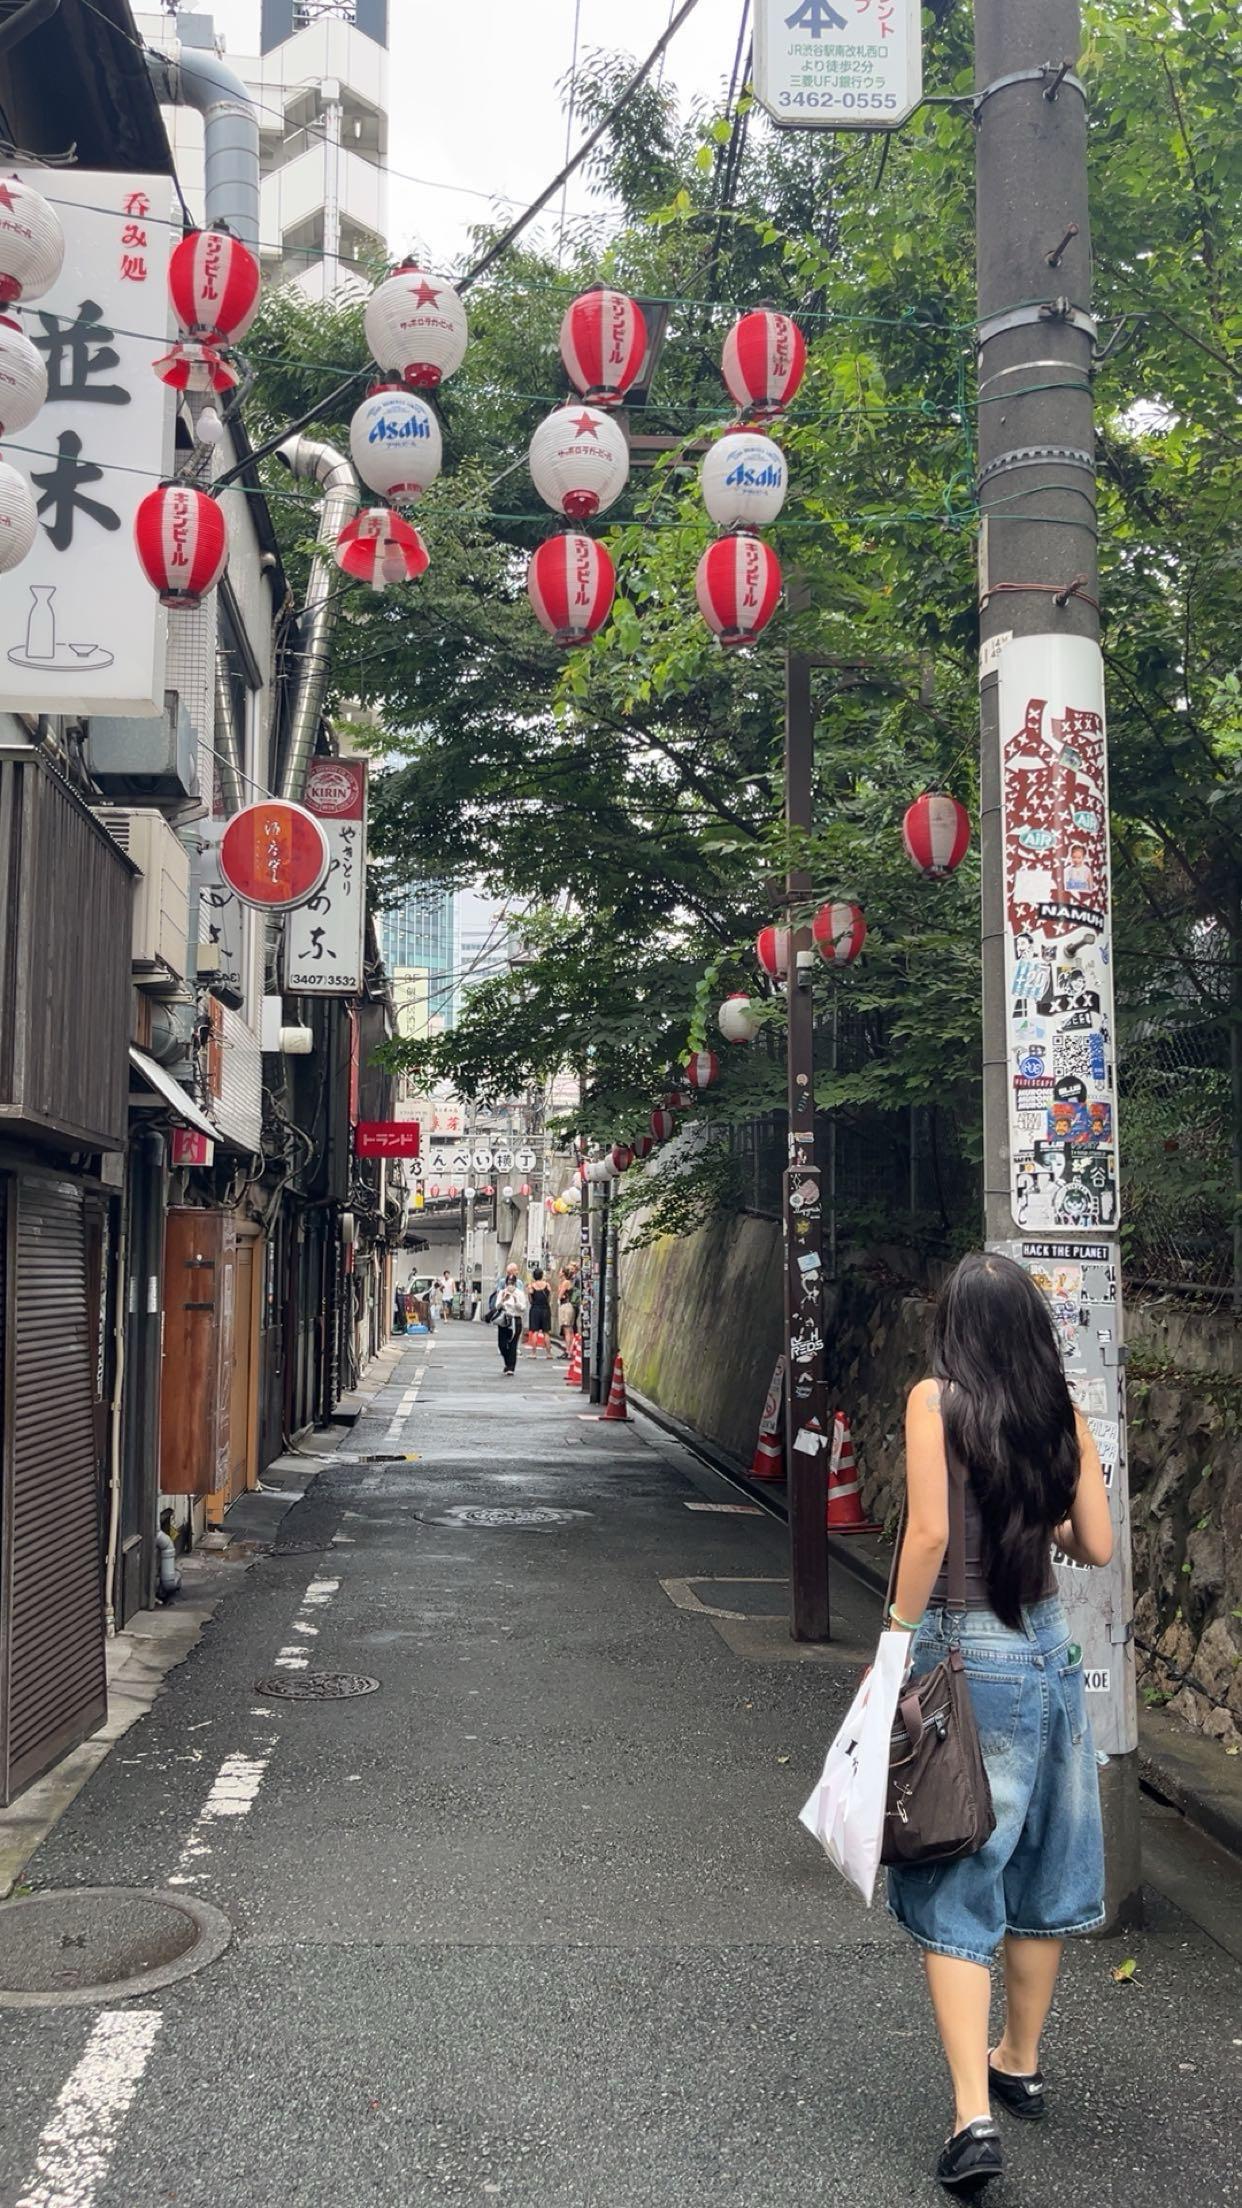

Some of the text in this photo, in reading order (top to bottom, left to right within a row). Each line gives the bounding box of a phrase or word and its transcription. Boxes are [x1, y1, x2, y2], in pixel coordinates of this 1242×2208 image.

[787, 44, 889, 58] JR渋谷駅南改札西口
[801, 60, 874, 74] より徒歩2分
[779, 91, 897, 109] 3462-0555
[790, 74, 886, 89] 三菱UFJ銀行ウラ
[121, 192, 150, 282] 呑み処
[201, 235, 224, 301] キリンビール
[609, 296, 627, 365] キリンビール
[30, 299, 132, 552] 並木
[368, 415, 431, 444] Asahi
[726, 462, 782, 489] Asahi
[171, 492, 189, 567] キリンビール
[575, 538, 591, 606] キリンビール
[743, 543, 759, 608] キリンビール
[312, 787, 346, 798] KIRIN
[339, 825, 356, 897] やきとり
[1024, 1245, 1108, 1259] HACK THE PLANET
